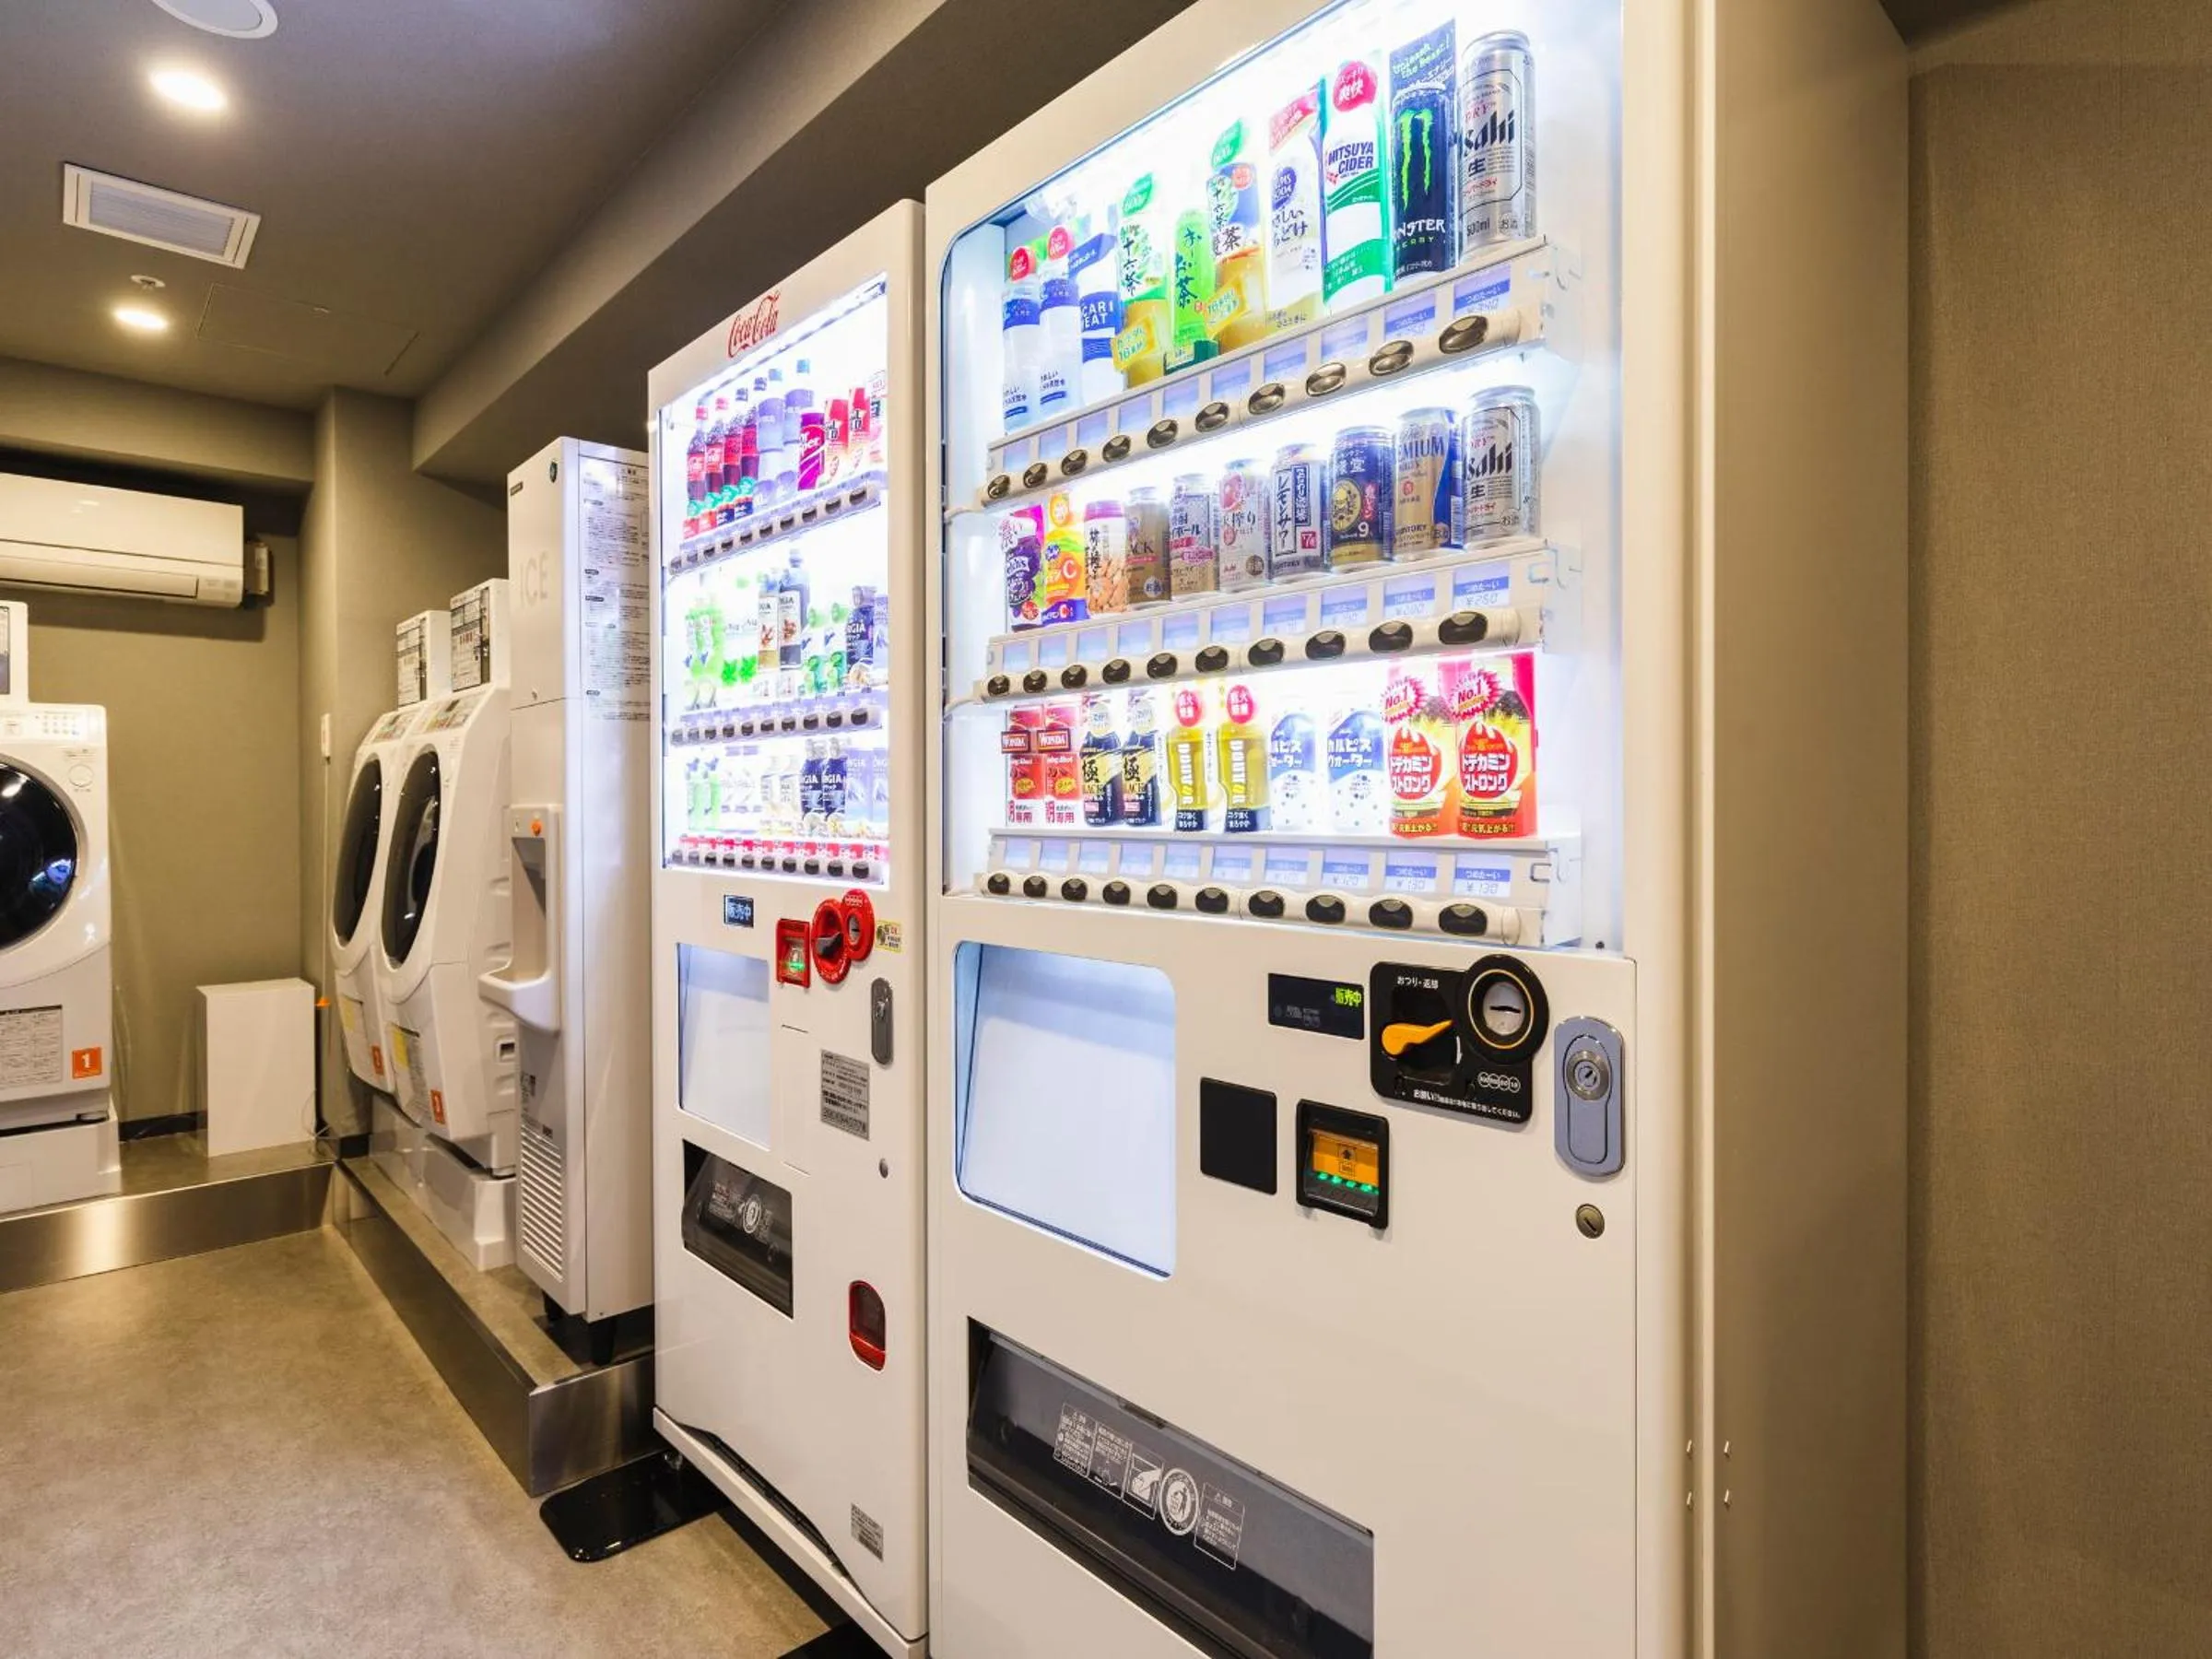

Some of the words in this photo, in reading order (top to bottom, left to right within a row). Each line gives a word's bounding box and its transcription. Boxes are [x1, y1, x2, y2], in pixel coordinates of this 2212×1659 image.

[1462, 110, 1515, 155] sahi
[1328, 141, 1374, 166] MITSUYA
[1338, 156, 1374, 174] CIDER
[1468, 157, 1486, 178] 生
[1396, 218, 1446, 242] NSTER
[1081, 301, 1114, 318] CARI
[1084, 312, 1107, 328] EAT
[728, 290, 782, 359] Coca-Cola
[1470, 484, 1486, 500] 生
[1277, 476, 1291, 548] レモンサワー
[519, 551, 548, 608] ICE
[1457, 679, 1482, 702] No.1
[1040, 732, 1066, 747] WONDA
[1464, 772, 1508, 793] ストロング
[1335, 986, 1362, 1007] 販売中
[81, 1053, 91, 1069] 1
